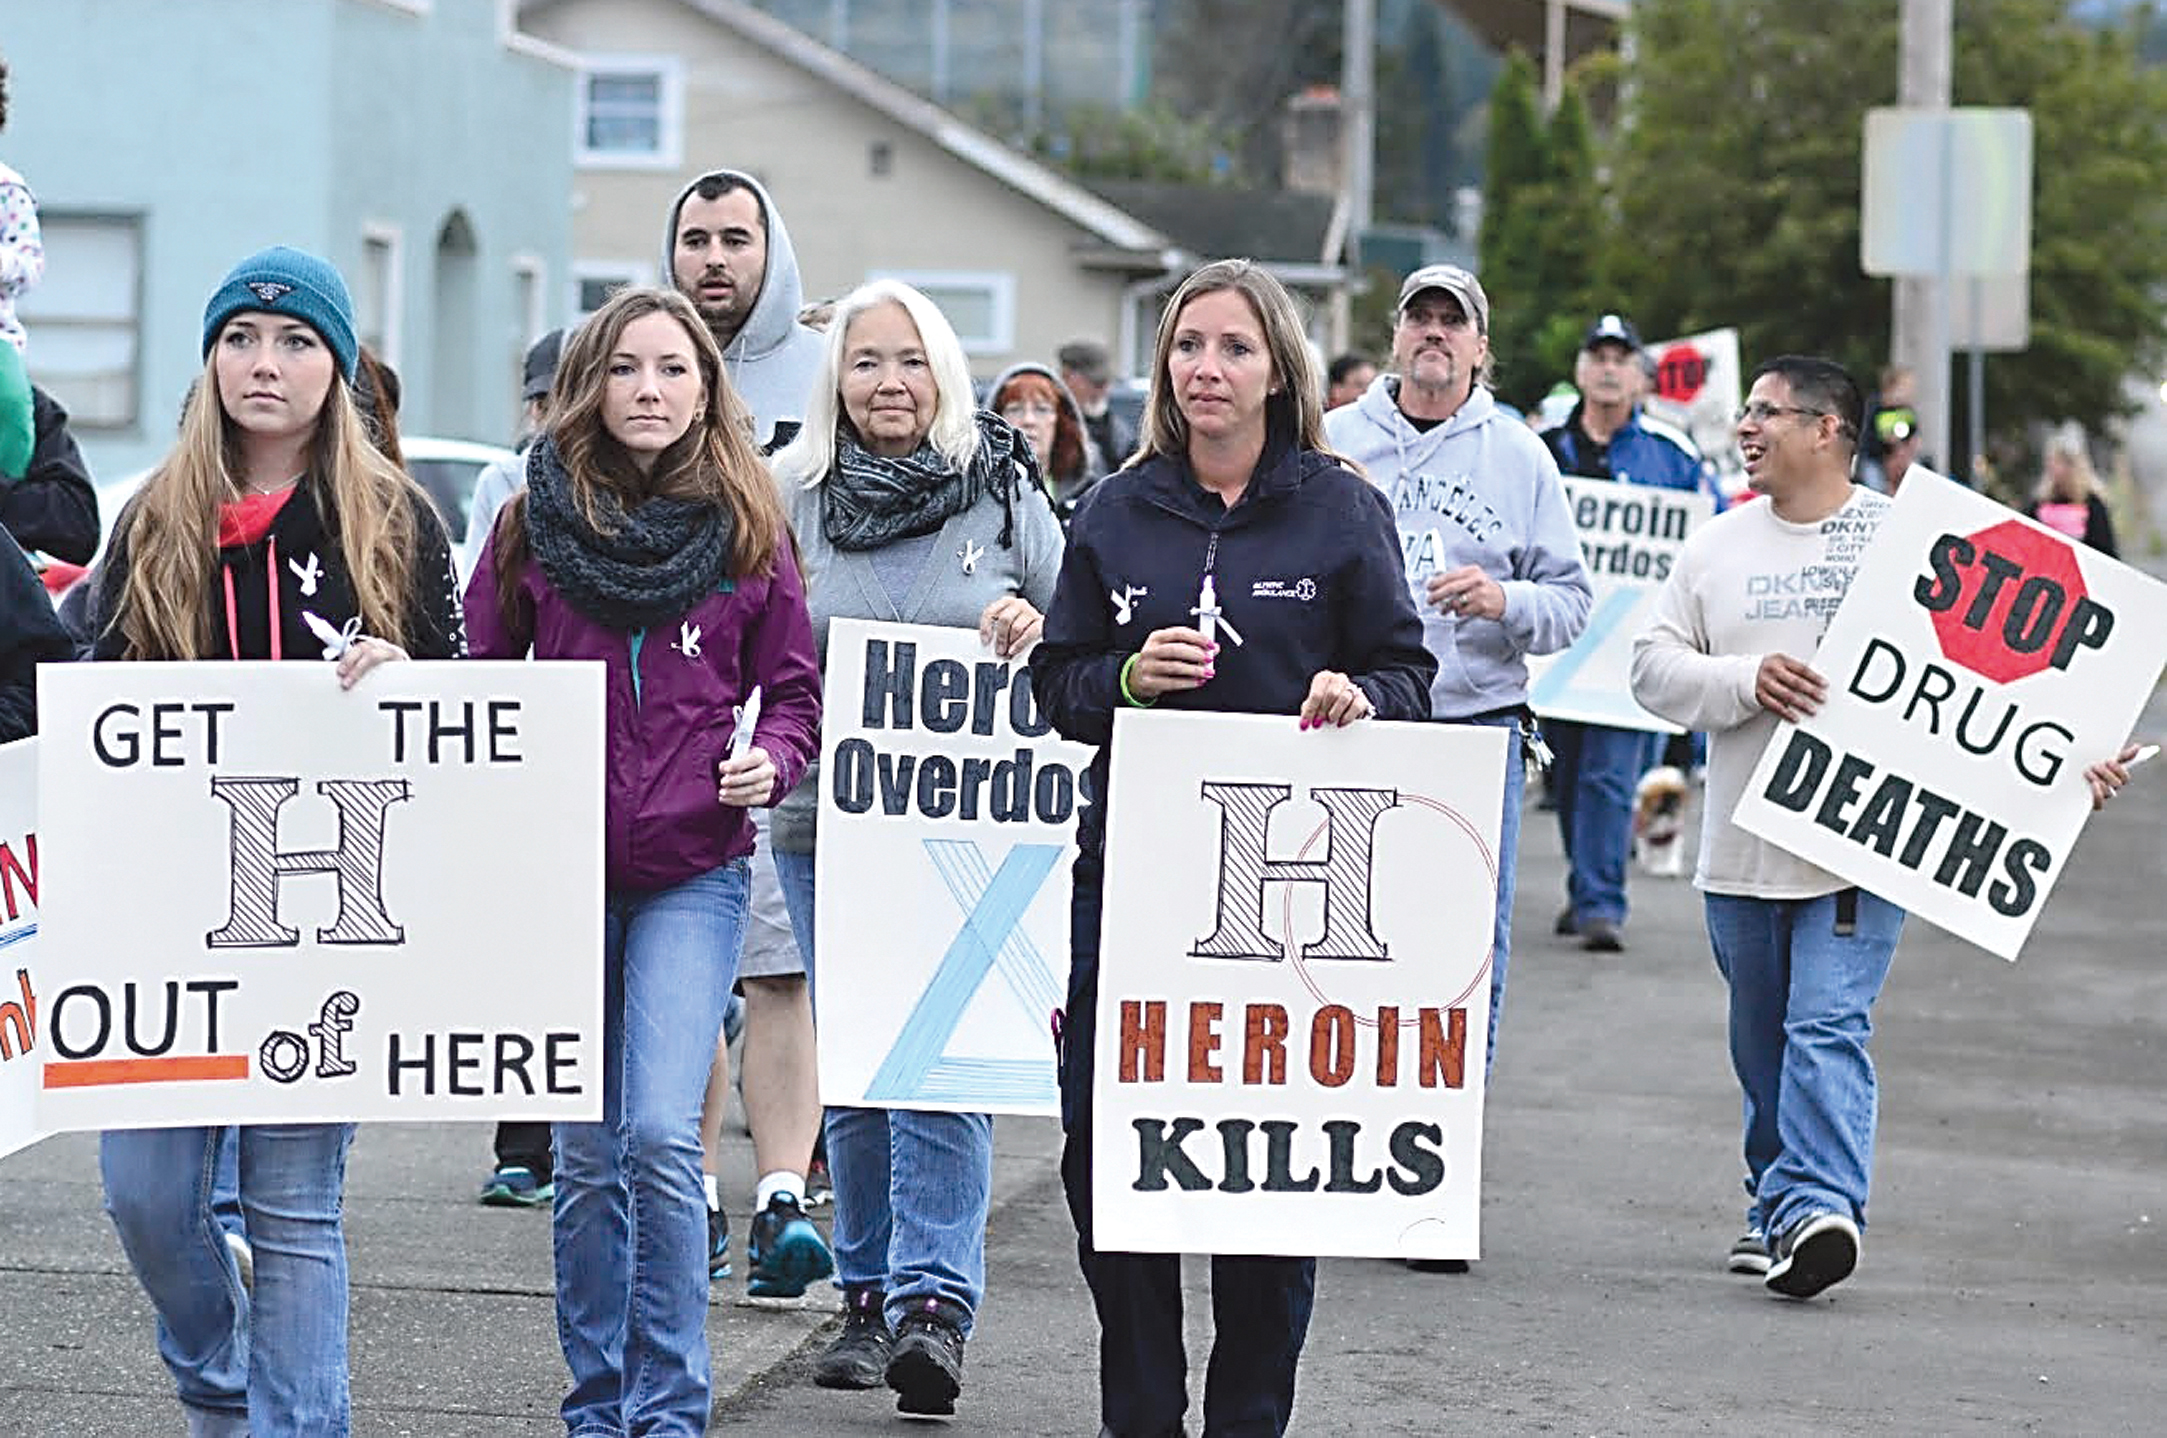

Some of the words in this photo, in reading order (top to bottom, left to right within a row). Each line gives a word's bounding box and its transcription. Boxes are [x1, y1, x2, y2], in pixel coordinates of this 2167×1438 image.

[1914, 533, 2115, 673] STOP
[93, 703, 235, 768] GET
[378, 701, 523, 764] THE
[1848, 637, 2075, 787] DRUG
[206, 775, 414, 948] H
[1186, 780, 1405, 961] H
[1763, 728, 2053, 919] DEATHS
[50, 980, 239, 1060] OUT
[259, 991, 360, 1083] of
[389, 1033, 583, 1096] HERE
[1118, 1001, 1467, 1089] HEROIN
[1131, 1118, 1446, 1196] KILLS
